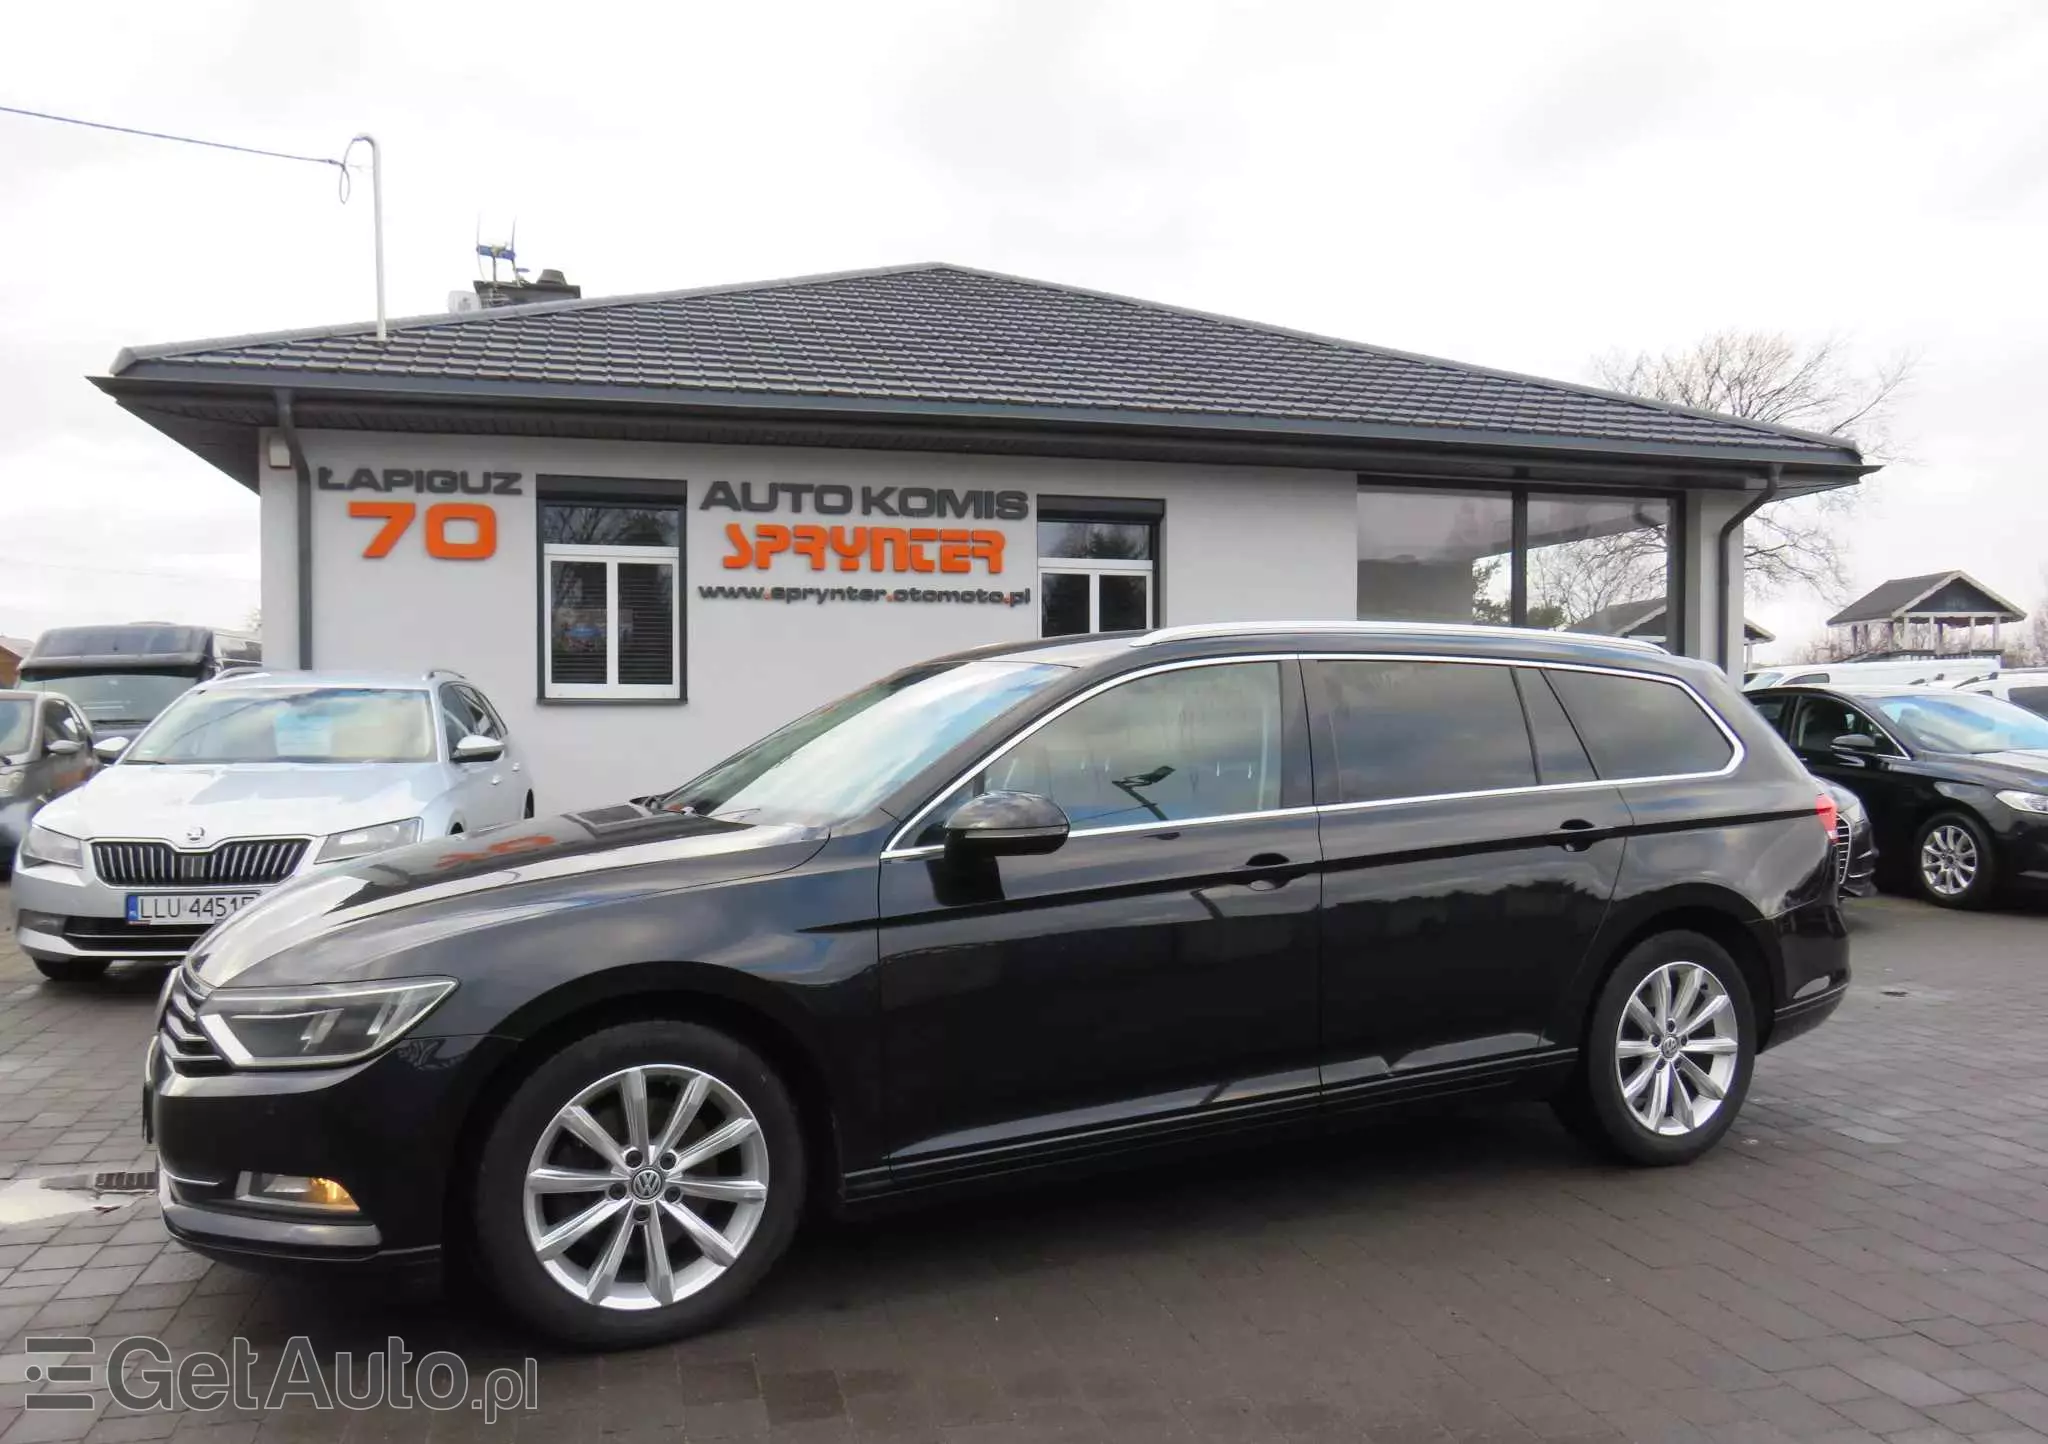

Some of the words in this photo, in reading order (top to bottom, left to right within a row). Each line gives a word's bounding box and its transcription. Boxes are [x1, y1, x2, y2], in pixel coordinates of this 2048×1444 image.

[318, 466, 522, 495] ŁAPIGUZ
[700, 481, 853, 514] AUTO
[861, 486, 1029, 520] KOMIS
[347, 501, 497, 560] 70
[722, 523, 1006, 574] SPRYNTER
[698, 585, 1031, 607] www.sprynter.otomoto.pl
[140, 898, 181, 918] LLU
